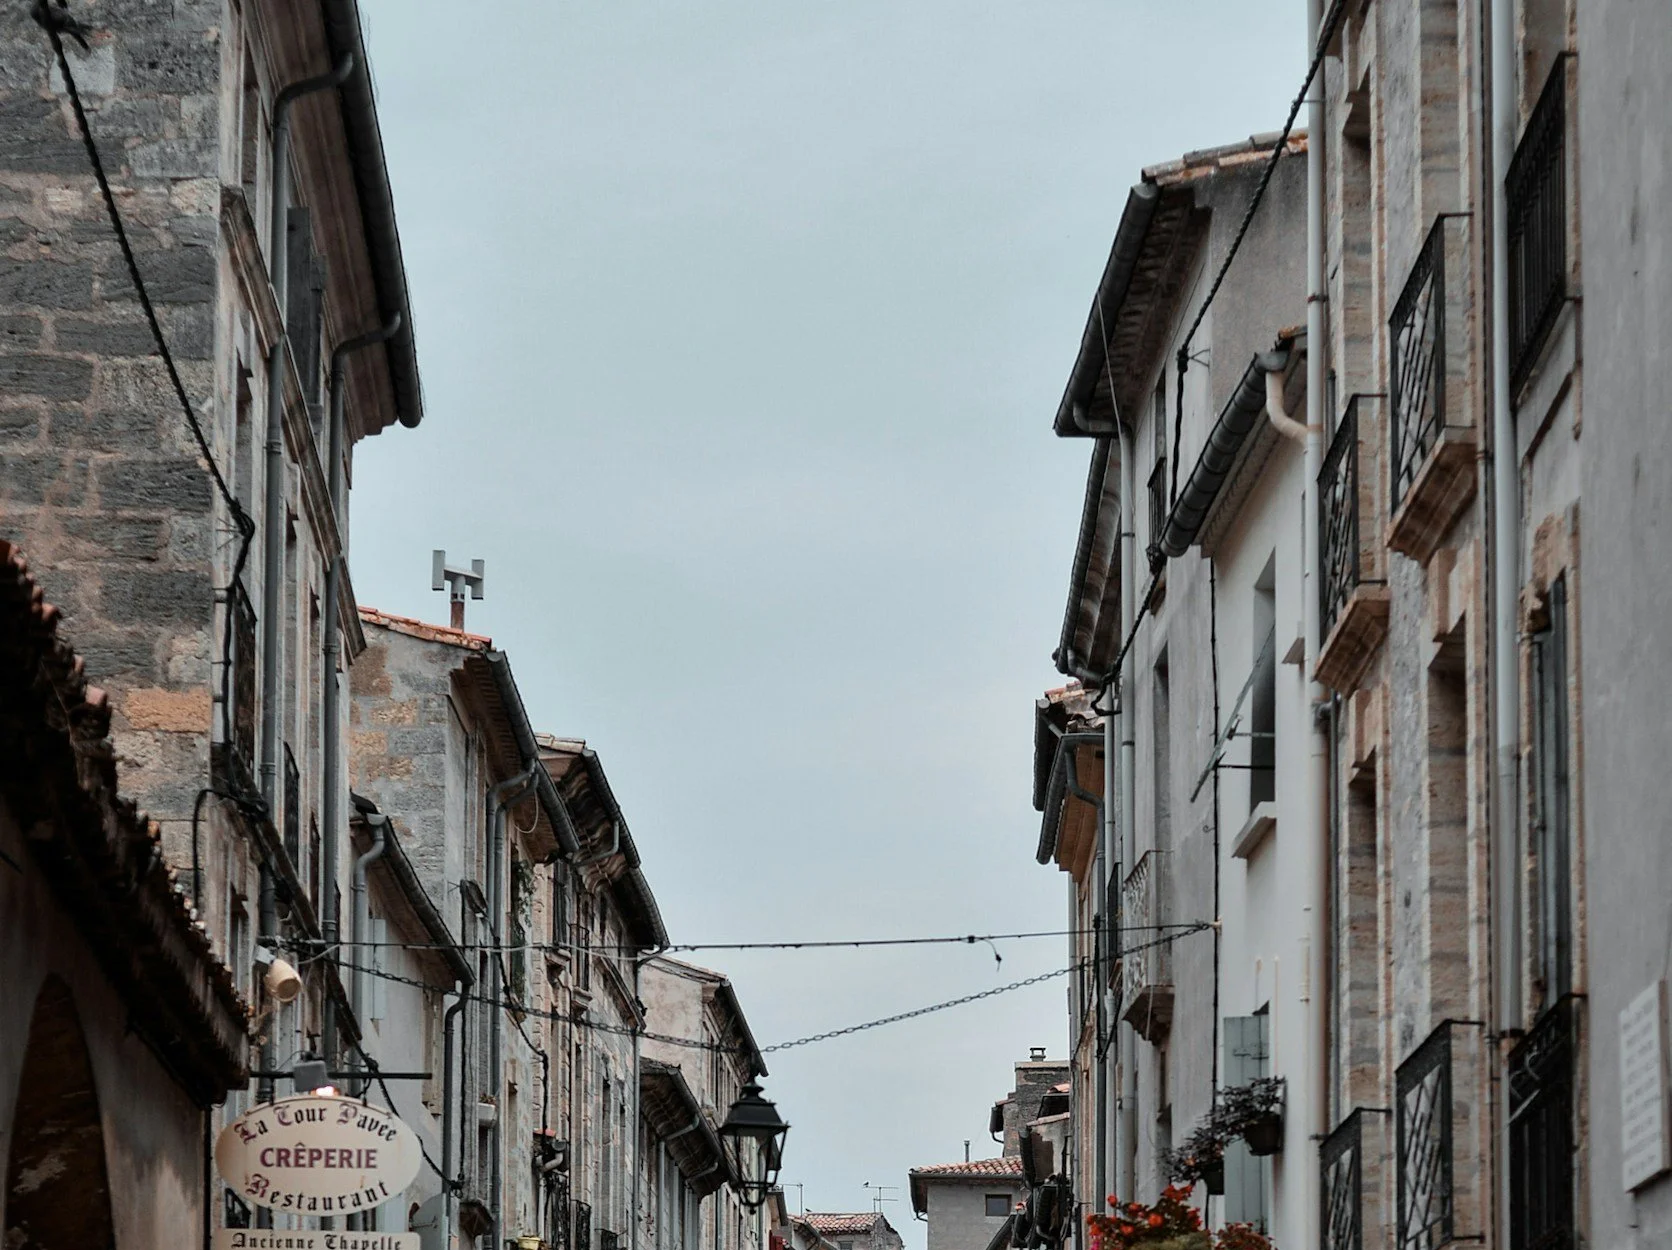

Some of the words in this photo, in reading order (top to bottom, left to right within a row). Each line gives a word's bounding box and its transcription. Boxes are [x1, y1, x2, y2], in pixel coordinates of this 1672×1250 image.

[234, 1120, 268, 1145] La
[260, 1142, 378, 1168] CRÊPERIE
[245, 1173, 389, 1212] Restaurant
[231, 1232, 315, 1250] Ancienne
